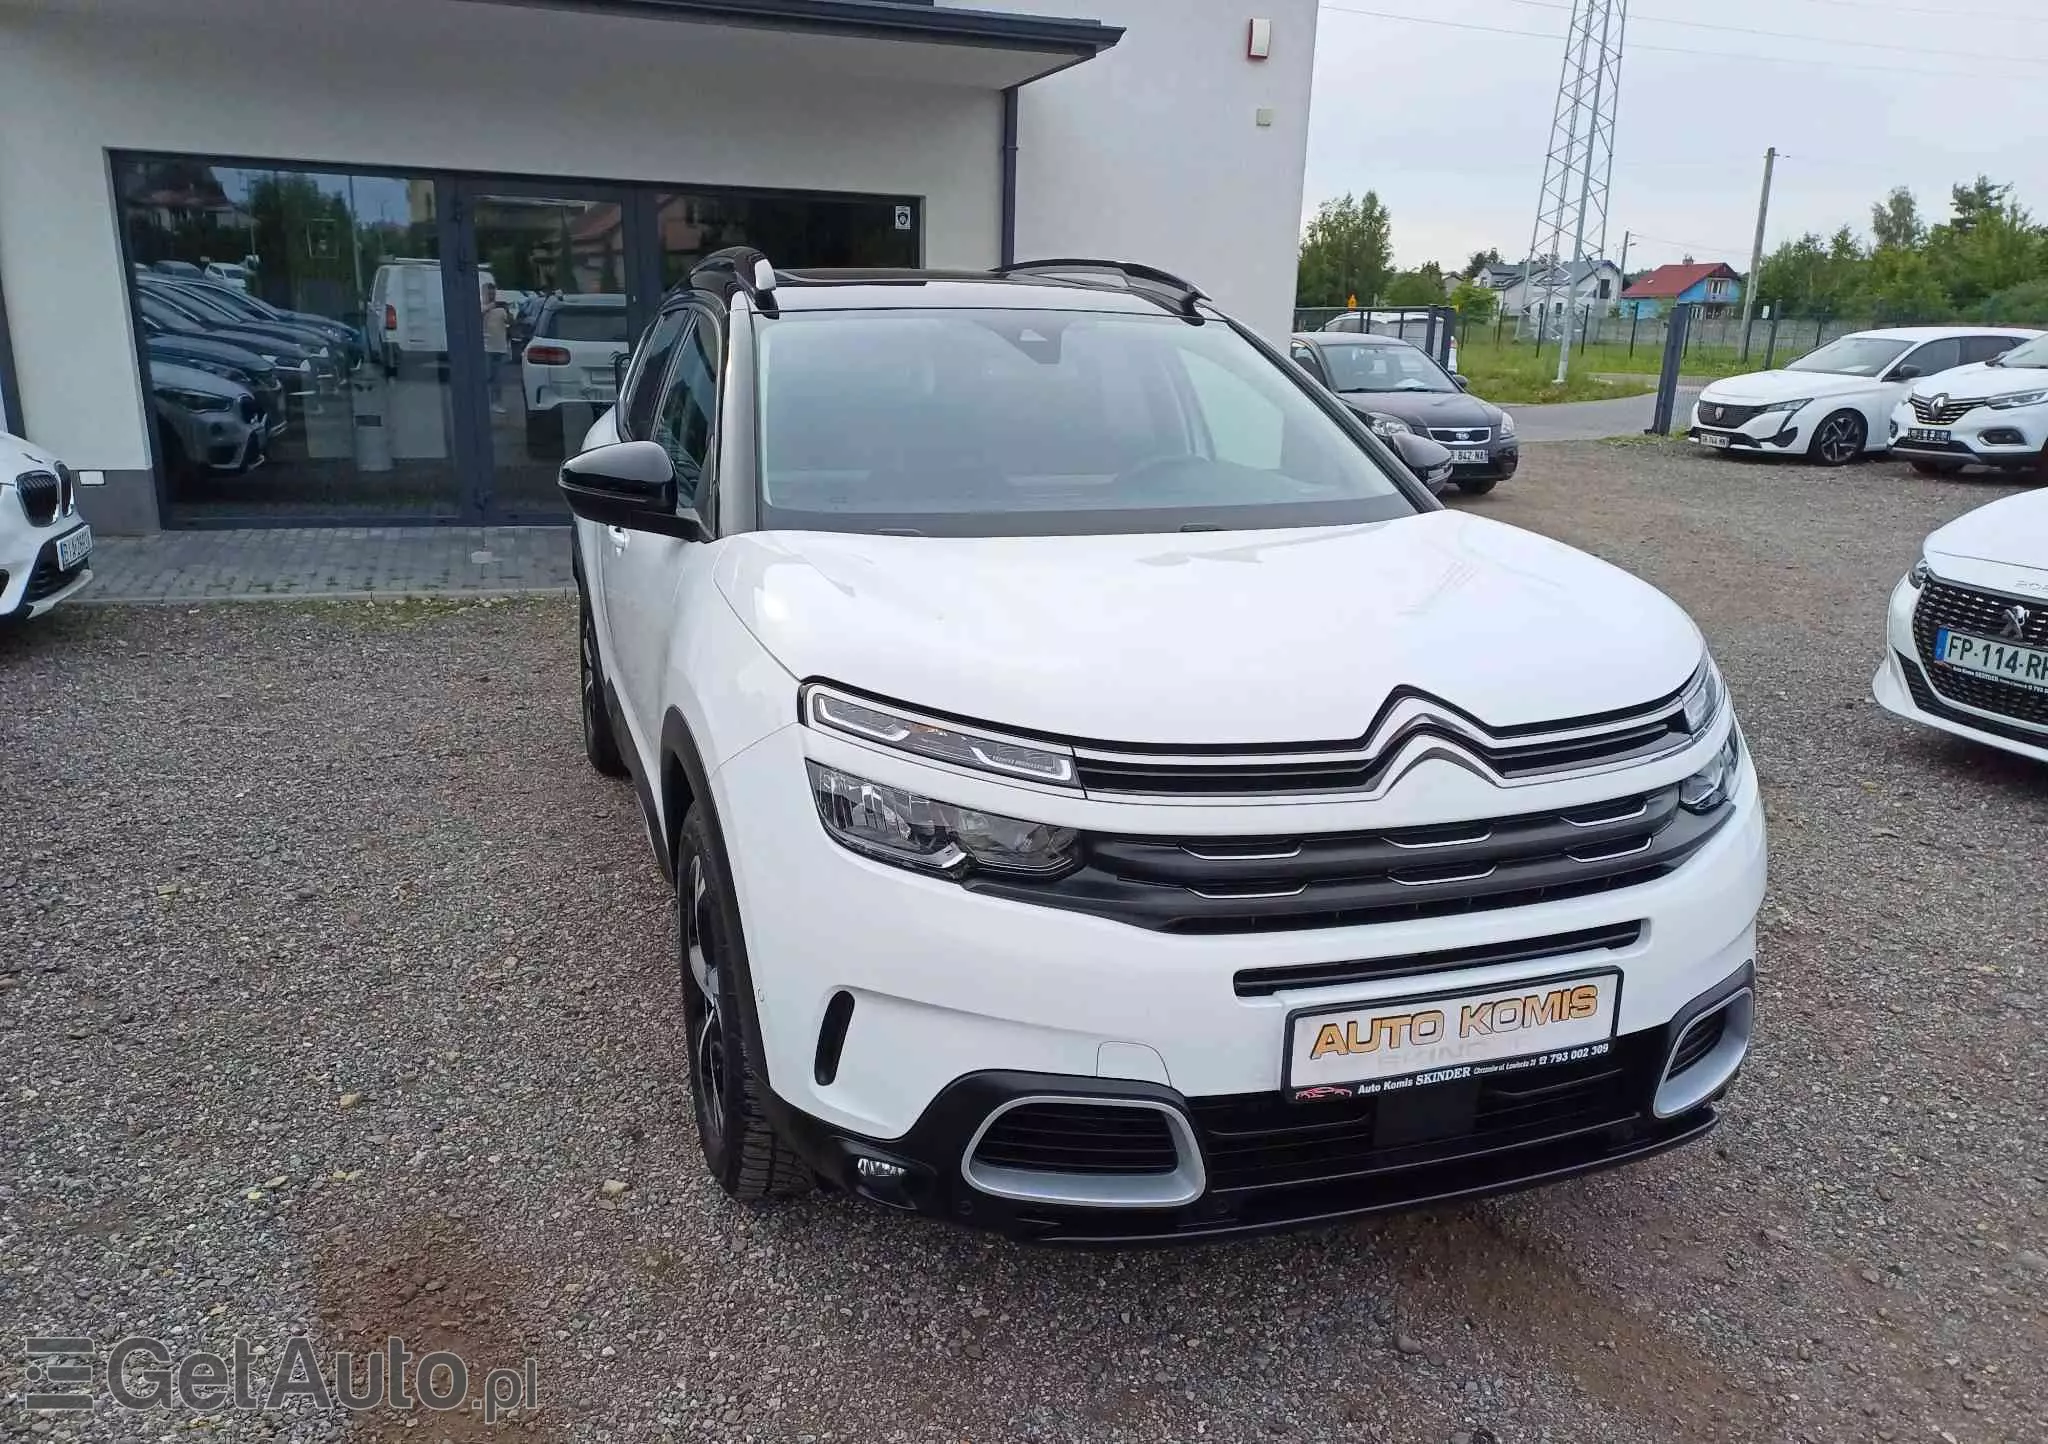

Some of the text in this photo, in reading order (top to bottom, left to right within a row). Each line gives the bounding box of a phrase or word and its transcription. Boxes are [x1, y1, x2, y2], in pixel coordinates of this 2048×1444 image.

[1310, 984, 1599, 1060] AUTO KOMIS
[1357, 1083, 1381, 1095] Auto
[1383, 1078, 1413, 1091] Komis
[1415, 1067, 1471, 1086] SKINDER
[1550, 1052, 1568, 1064] 793
[1571, 1047, 1589, 1060] 002
[1591, 1043, 1609, 1055] 309
